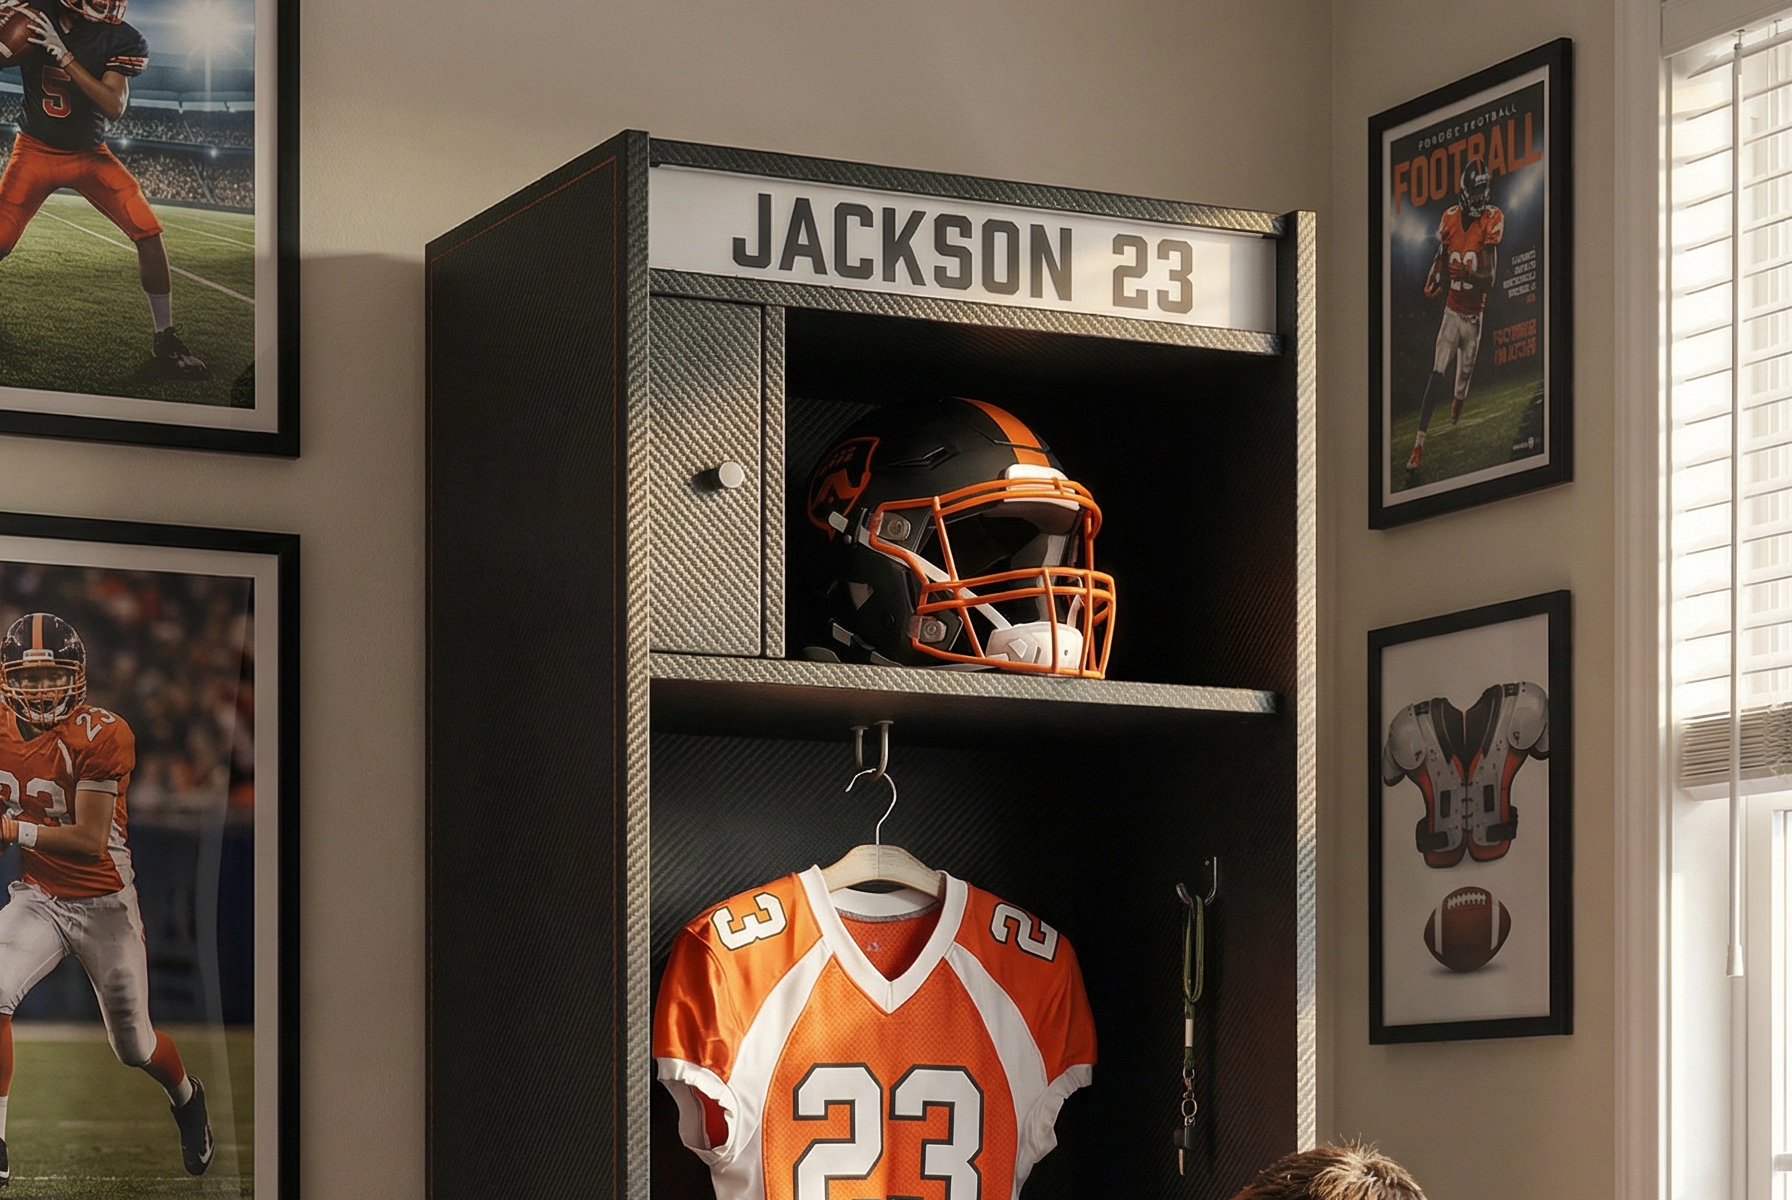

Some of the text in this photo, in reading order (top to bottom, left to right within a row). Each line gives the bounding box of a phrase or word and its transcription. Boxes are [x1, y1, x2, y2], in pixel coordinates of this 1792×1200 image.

[42, 65, 71, 118] 5
[1394, 111, 1542, 215] FOOTBALL
[731, 192, 1194, 315] JACKSON 23
[76, 707, 116, 742] 23
[711, 891, 789, 951] 3
[989, 902, 1060, 962] 2
